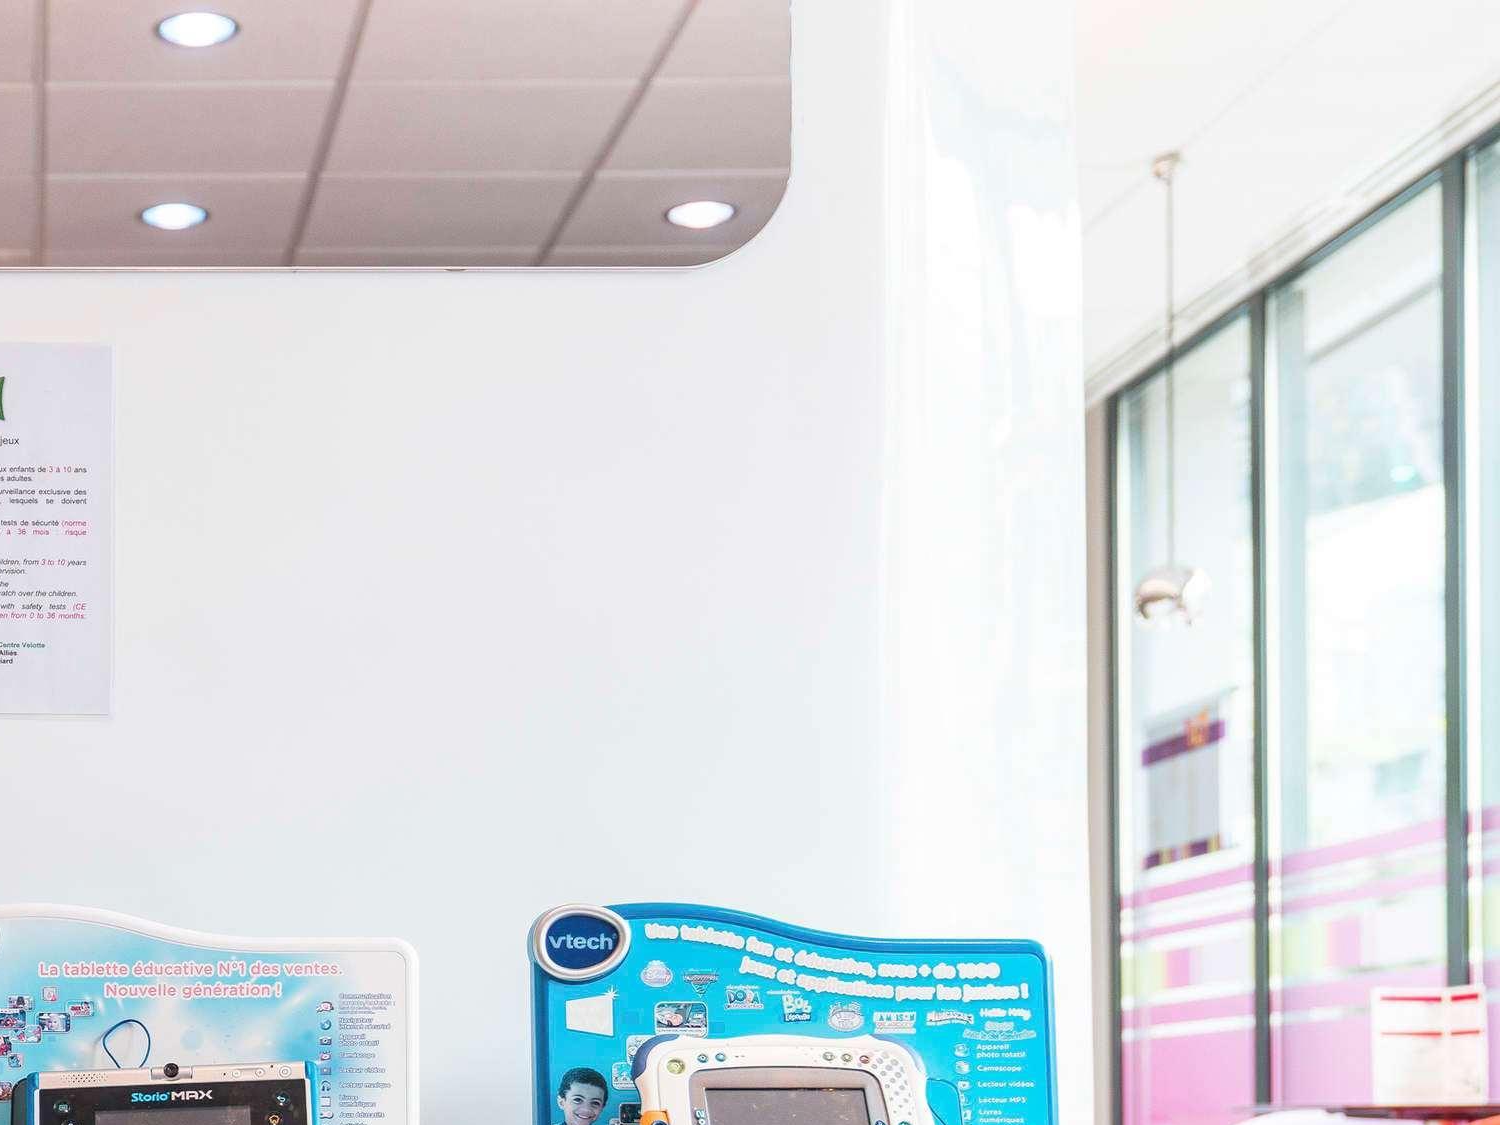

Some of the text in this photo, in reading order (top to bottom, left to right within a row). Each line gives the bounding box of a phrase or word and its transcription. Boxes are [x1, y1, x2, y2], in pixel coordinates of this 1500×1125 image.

[0, 436, 20, 446] jeux
[548, 933, 614, 952] vtech
[39, 963, 58, 976] La
[63, 962, 128, 976] tablette
[133, 962, 213, 976] éducative
[250, 962, 279, 976] des
[284, 963, 342, 976] ventes.
[105, 983, 270, 1000] Nouvelle génération
[977, 1051, 1000, 1059] photo
[131, 1090, 213, 1102] Storio MAX
